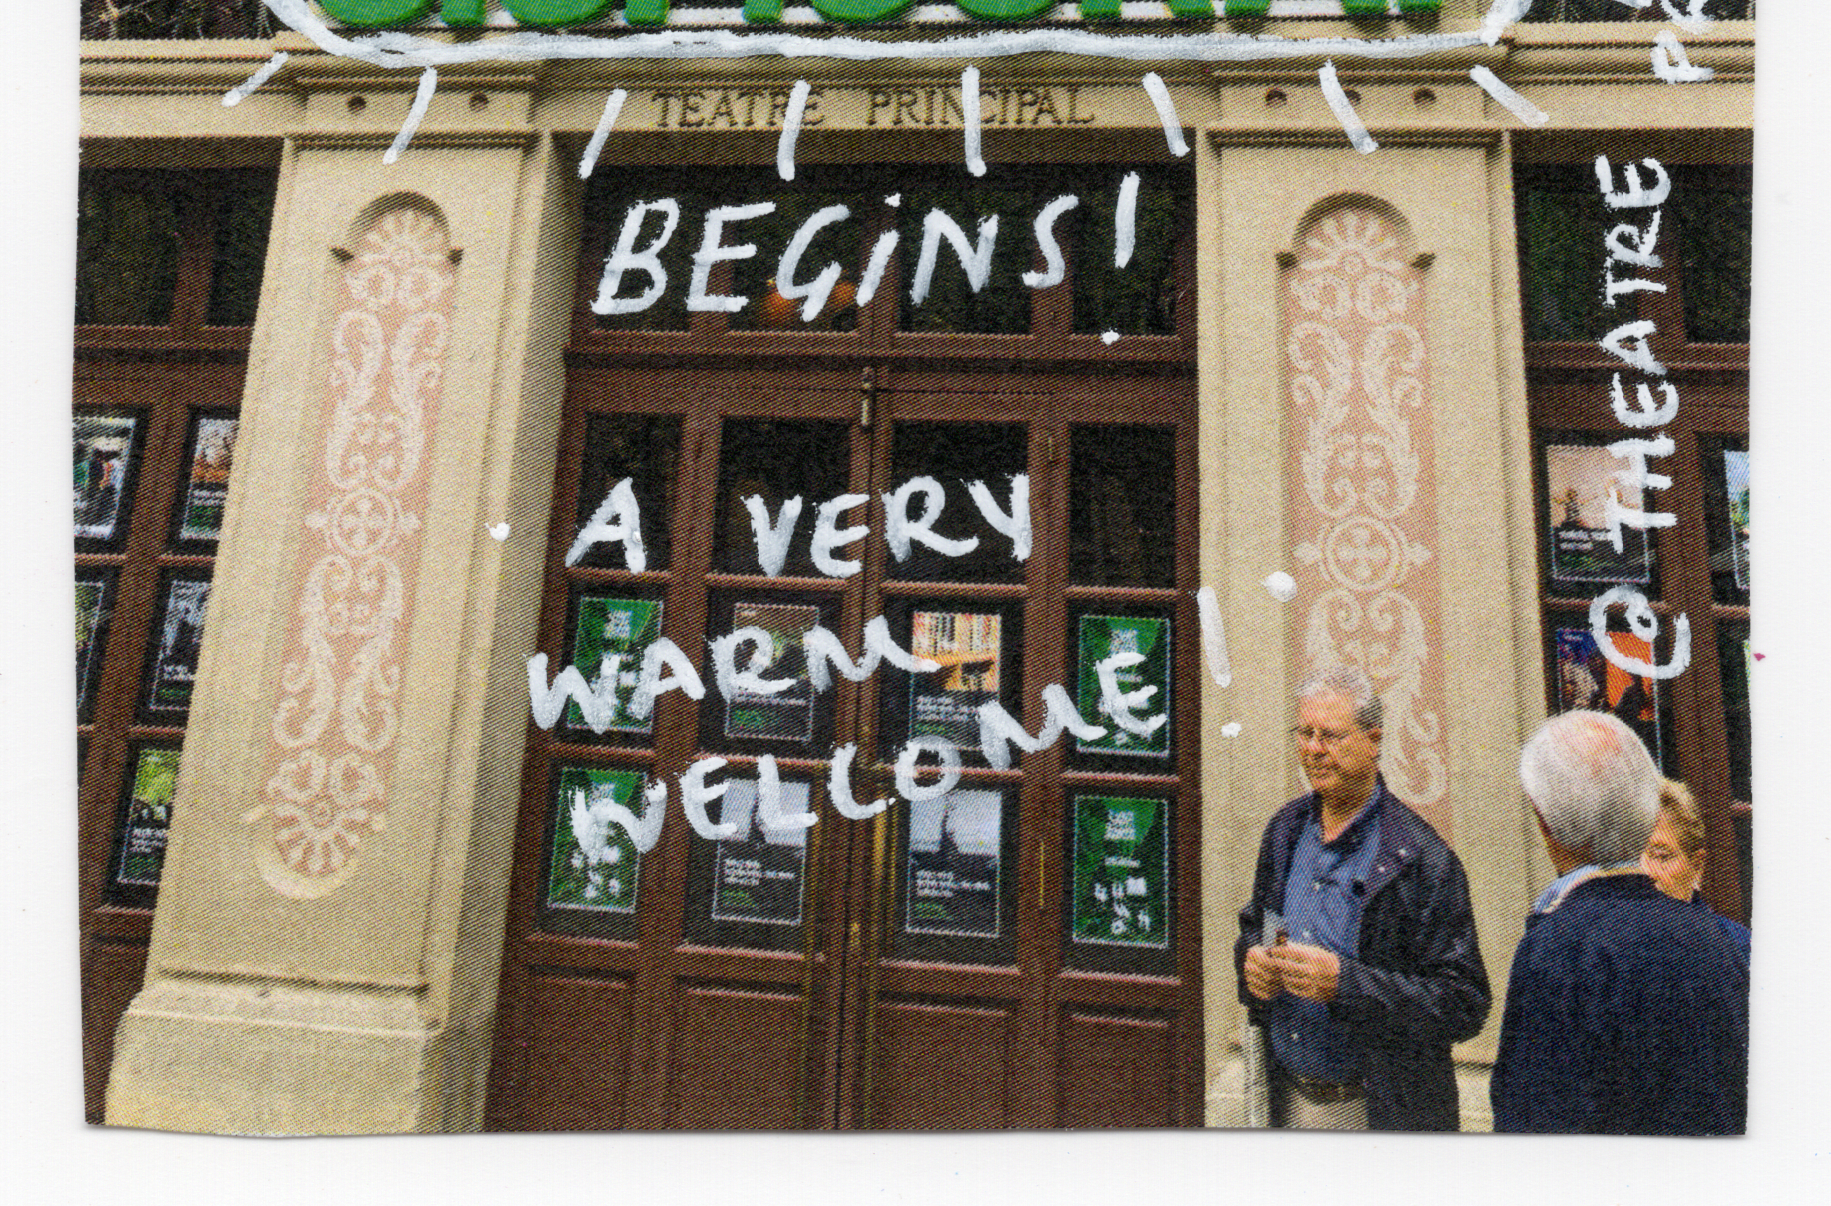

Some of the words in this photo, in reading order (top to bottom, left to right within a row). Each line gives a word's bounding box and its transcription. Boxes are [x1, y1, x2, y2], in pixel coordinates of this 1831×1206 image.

[653, 89, 824, 128] TEATRE
[867, 88, 1095, 126] PRINCIPAL
[1594, 154, 1679, 554] THEATRE
[566, 477, 647, 574] A
[739, 473, 1031, 578] VERY
[524, 615, 942, 734] WARM
